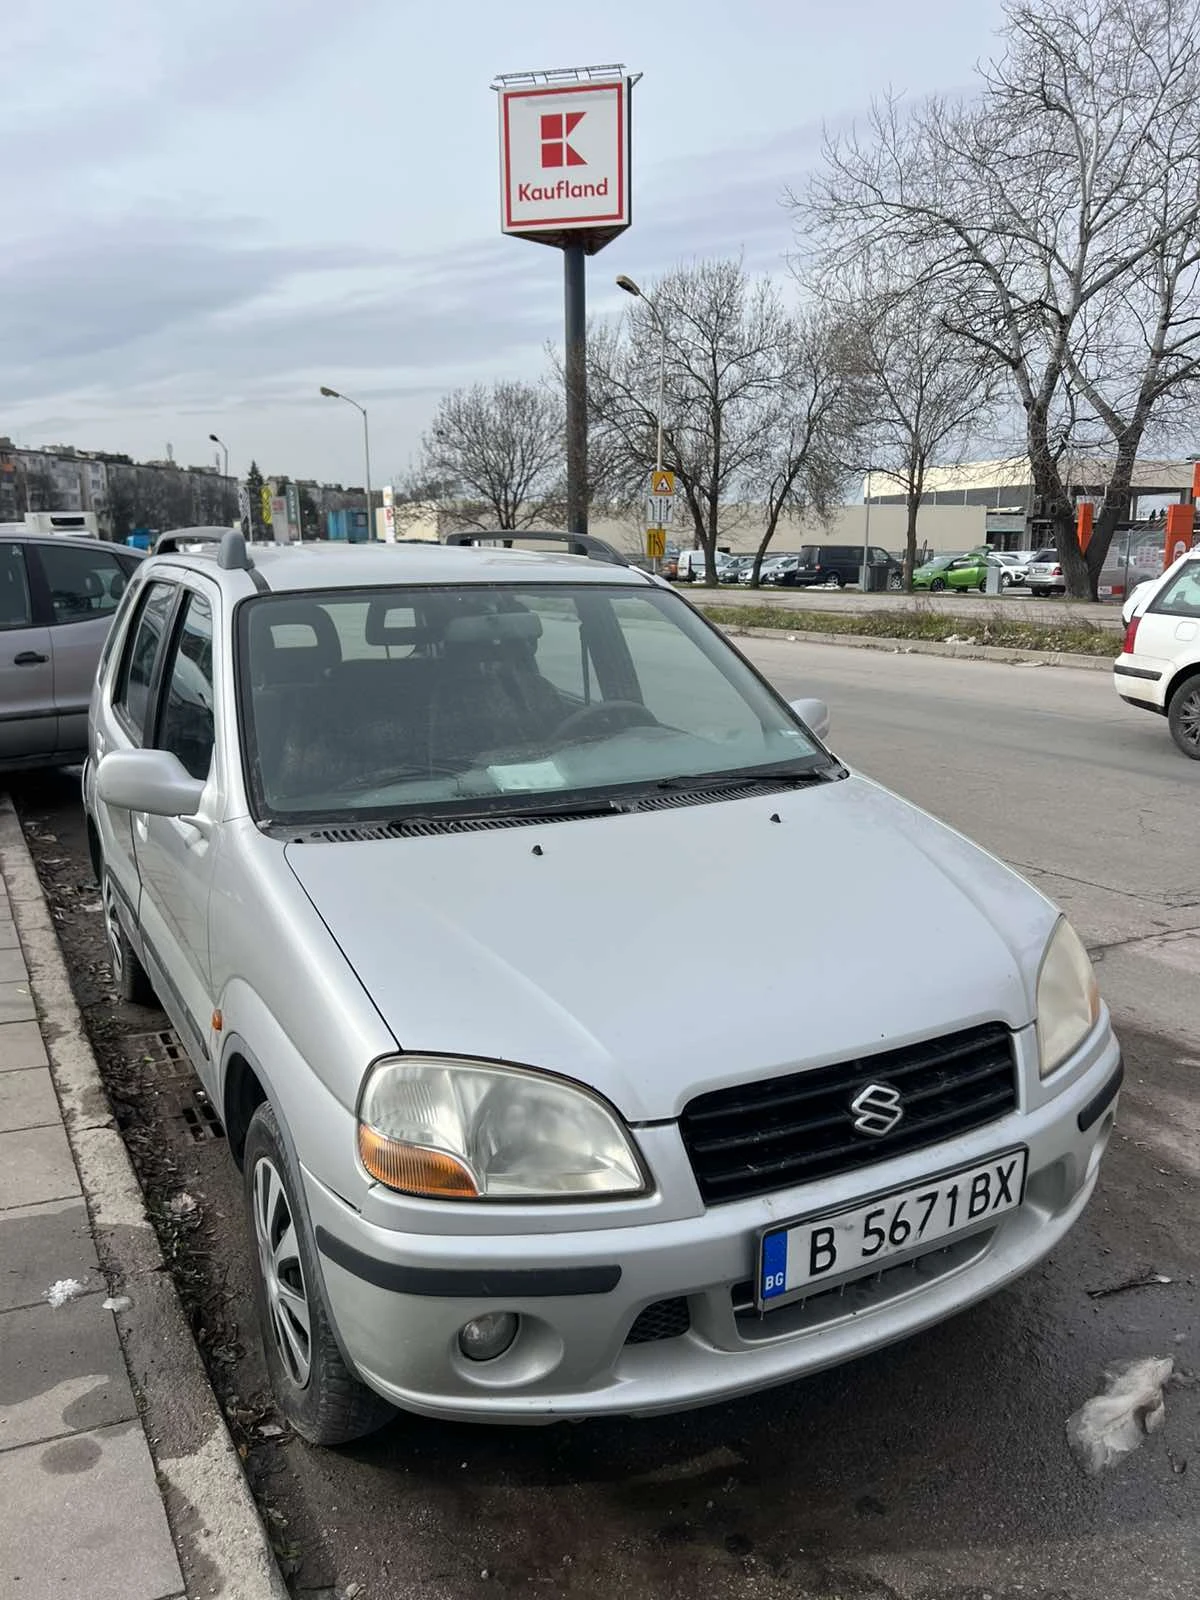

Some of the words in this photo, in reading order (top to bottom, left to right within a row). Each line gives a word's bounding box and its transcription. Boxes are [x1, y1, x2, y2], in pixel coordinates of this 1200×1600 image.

[518, 177, 608, 202] Kaufland
[809, 1226, 837, 1276] B
[764, 1271, 785, 1291] BG
